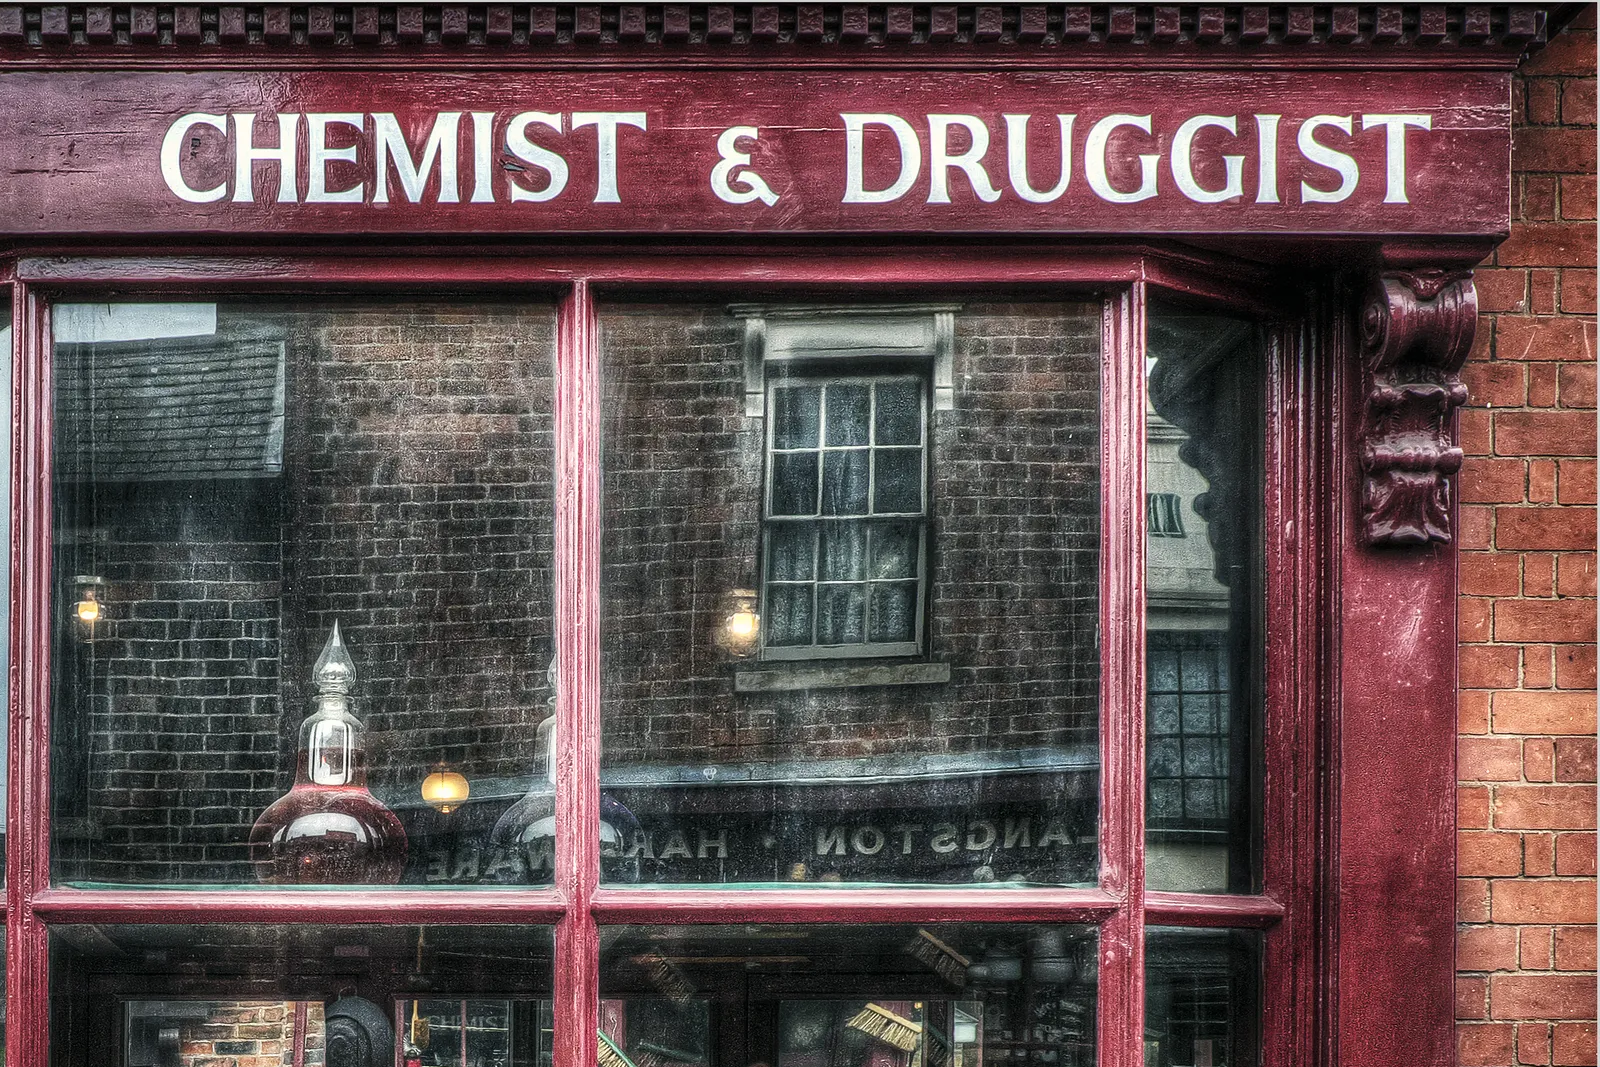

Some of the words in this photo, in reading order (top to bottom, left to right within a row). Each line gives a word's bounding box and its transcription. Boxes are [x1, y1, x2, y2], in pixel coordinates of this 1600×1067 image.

[159, 111, 648, 206] CHEMIST
[709, 124, 782, 208] &
[838, 113, 1433, 207] DRUGGIST
